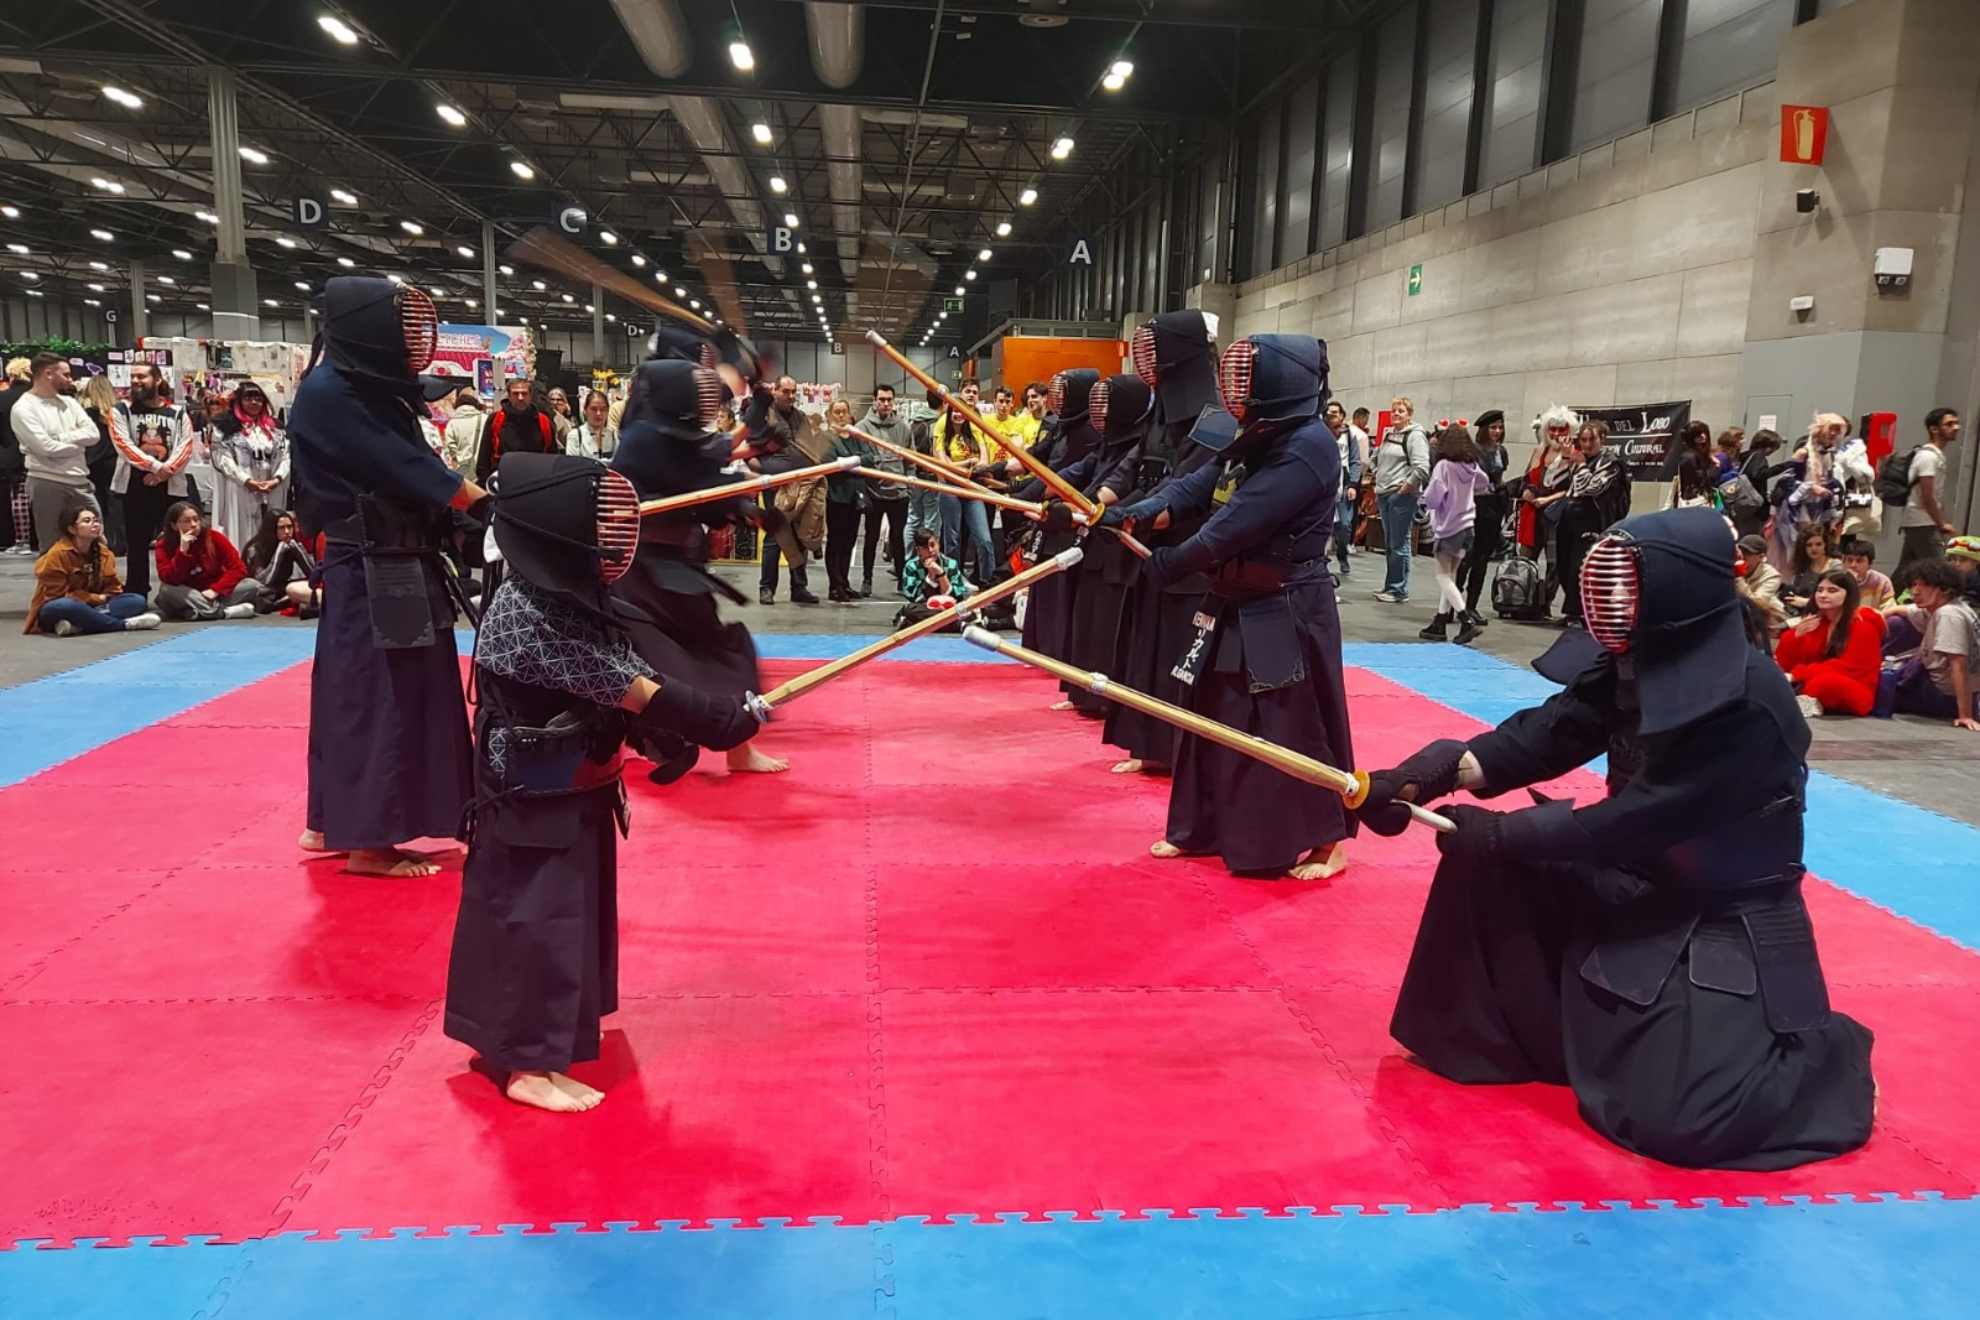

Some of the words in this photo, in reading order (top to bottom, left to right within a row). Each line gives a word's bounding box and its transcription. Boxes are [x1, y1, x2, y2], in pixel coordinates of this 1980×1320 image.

[299, 199, 321, 223] D
[561, 208, 587, 232] C
[775, 228, 792, 251] B
[1069, 240, 1092, 265] A
[105, 310, 117, 322] G
[628, 324, 638, 336] D
[834, 342, 843, 354] B
[949, 346, 960, 357] A
[1614, 419, 1636, 432] DEL
